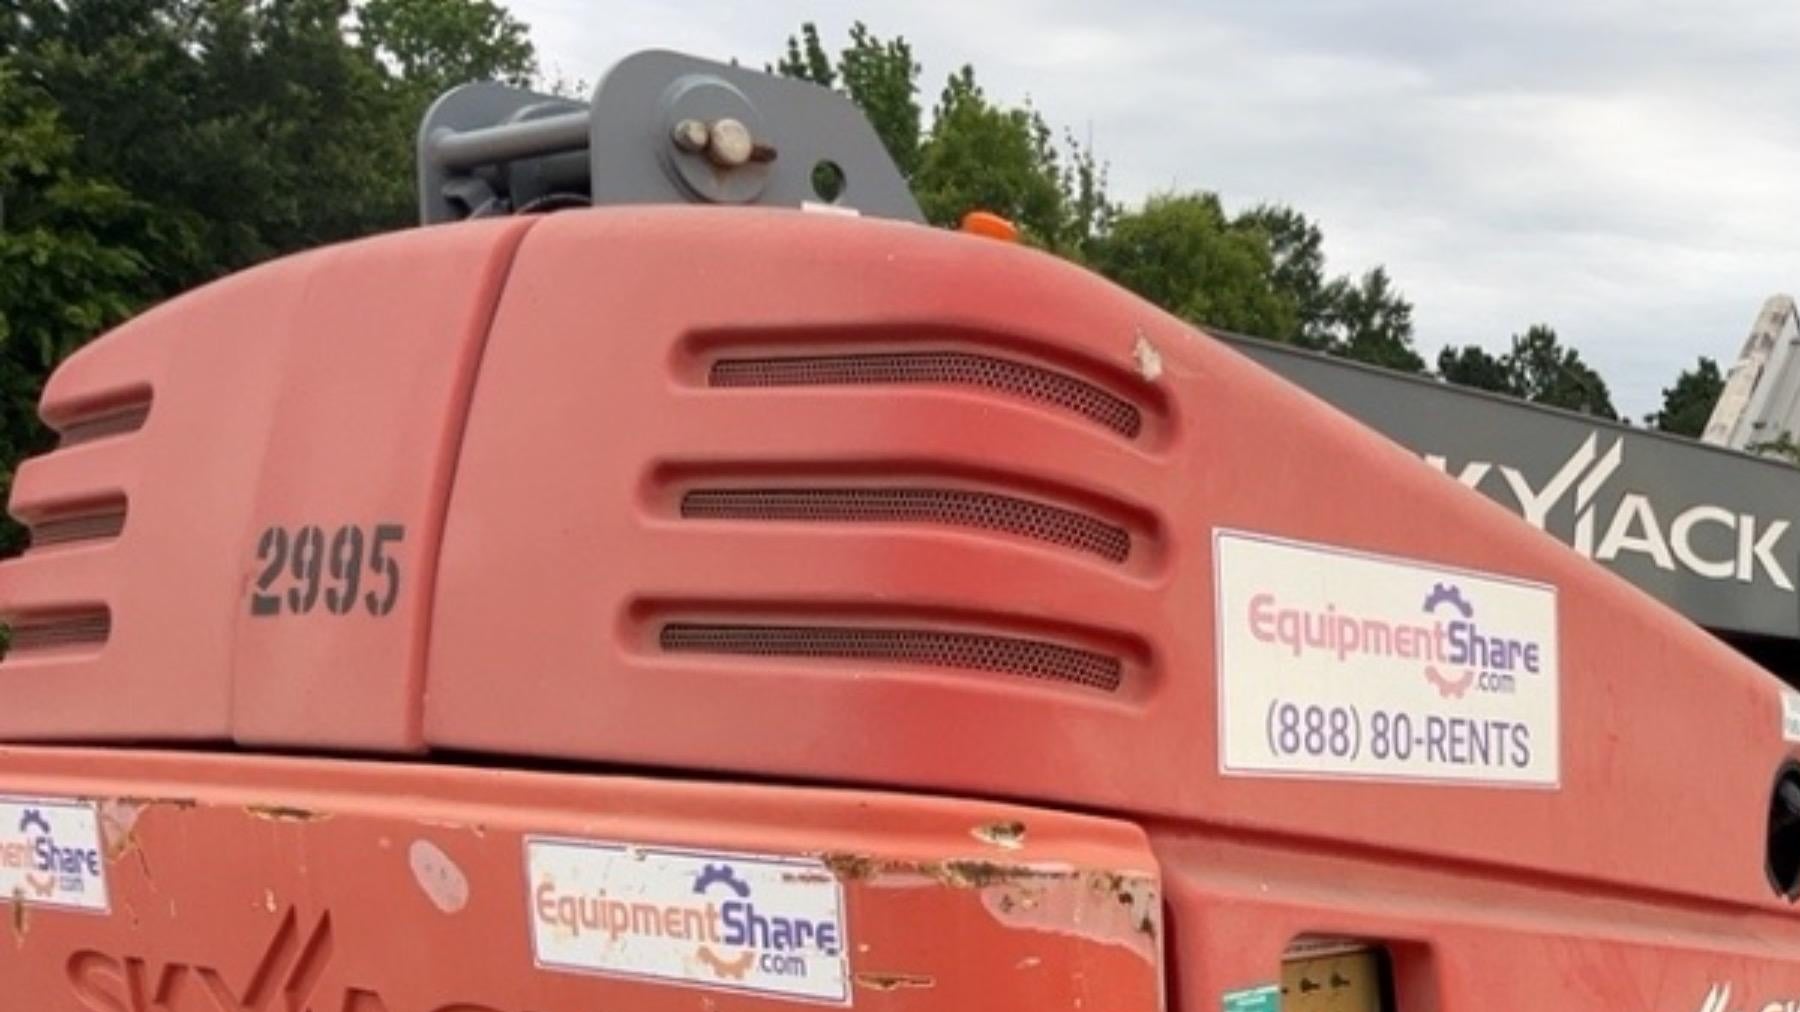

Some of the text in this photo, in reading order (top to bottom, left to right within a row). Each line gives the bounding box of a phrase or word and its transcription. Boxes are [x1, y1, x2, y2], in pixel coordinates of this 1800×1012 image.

[251, 524, 405, 616] 2995
[1248, 593, 1540, 674] EquipmentShare
[1266, 699, 1531, 769] (888) 80-RENTS
[536, 880, 838, 956] EquipmentShare
